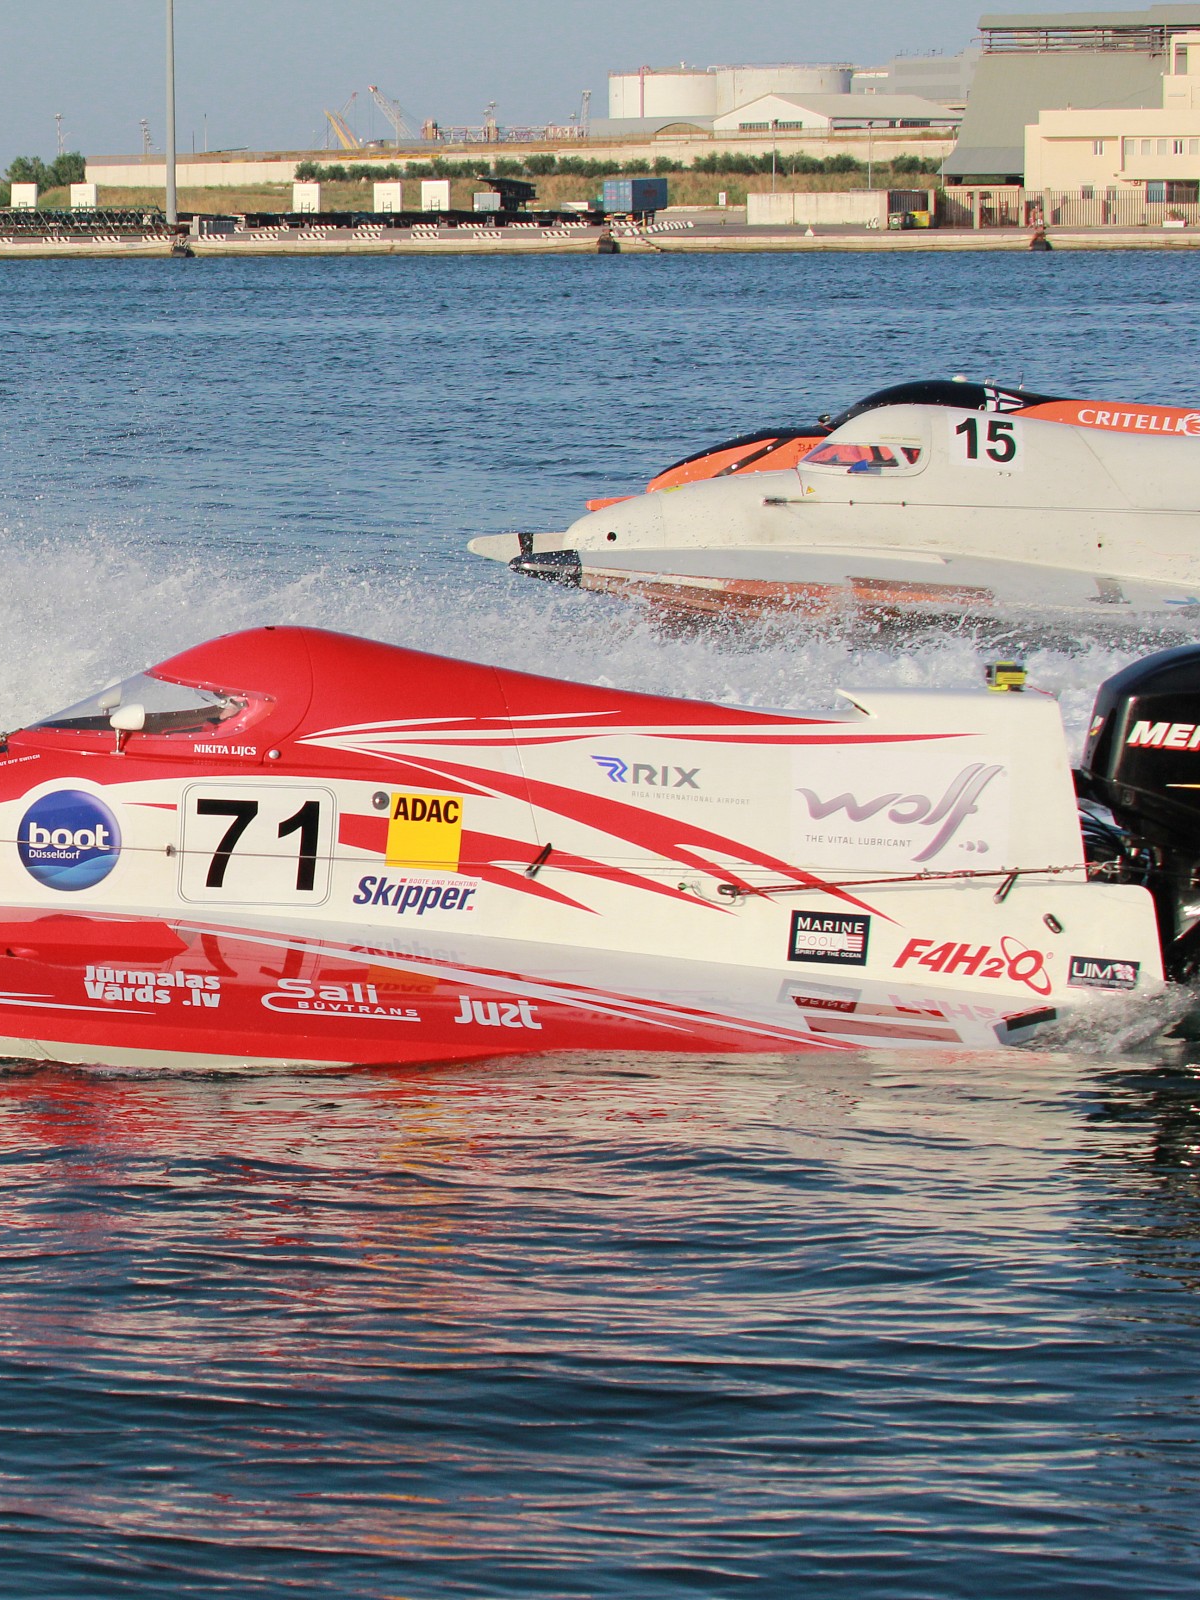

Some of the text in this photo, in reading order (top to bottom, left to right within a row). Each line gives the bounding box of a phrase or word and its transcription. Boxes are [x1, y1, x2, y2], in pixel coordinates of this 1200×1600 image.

[955, 417, 1017, 463] 15
[1125, 720, 1200, 752] ME
[193, 744, 257, 757] NIKITA LIJCS
[631, 791, 750, 805] RIGA INTERNATIONAL AIRPORT
[393, 797, 460, 824] ADAC
[28, 822, 110, 850] boot
[197, 798, 320, 891] 71
[805, 834, 912, 848] THE VITAL LUBRICANT
[28, 849, 81, 859] Düsseldorf
[797, 916, 865, 934] MARINE
[797, 935, 836, 948] POOL
[83, 965, 221, 990] Jūrmalas
[1072, 961, 1112, 979] UIM
[276, 977, 379, 1004] Sali
